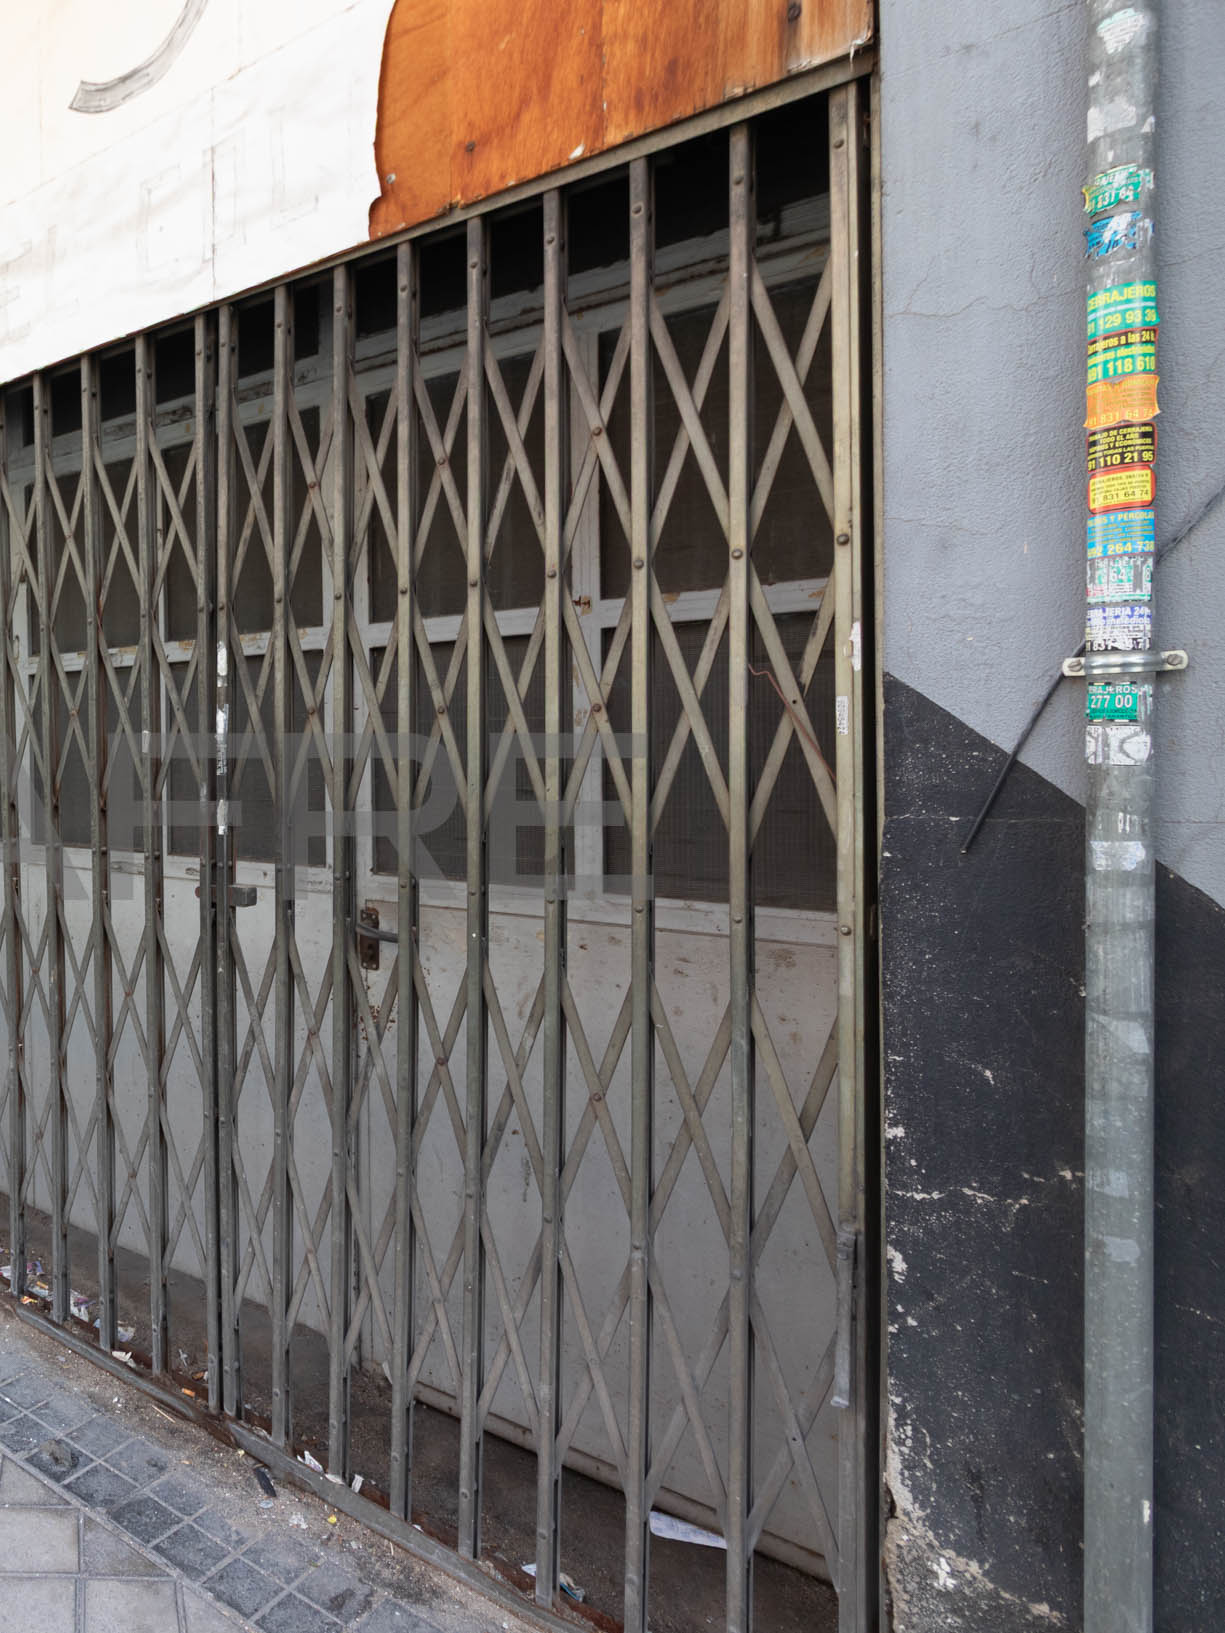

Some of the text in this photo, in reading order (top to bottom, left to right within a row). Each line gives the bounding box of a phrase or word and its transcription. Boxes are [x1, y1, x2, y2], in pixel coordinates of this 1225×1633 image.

[1107, 357, 1132, 376] 118
[1099, 454, 1120, 467] 110
[1124, 452, 1138, 463] 21
[1142, 451, 1153, 461] 95
[1091, 694, 1133, 708] 277 00
